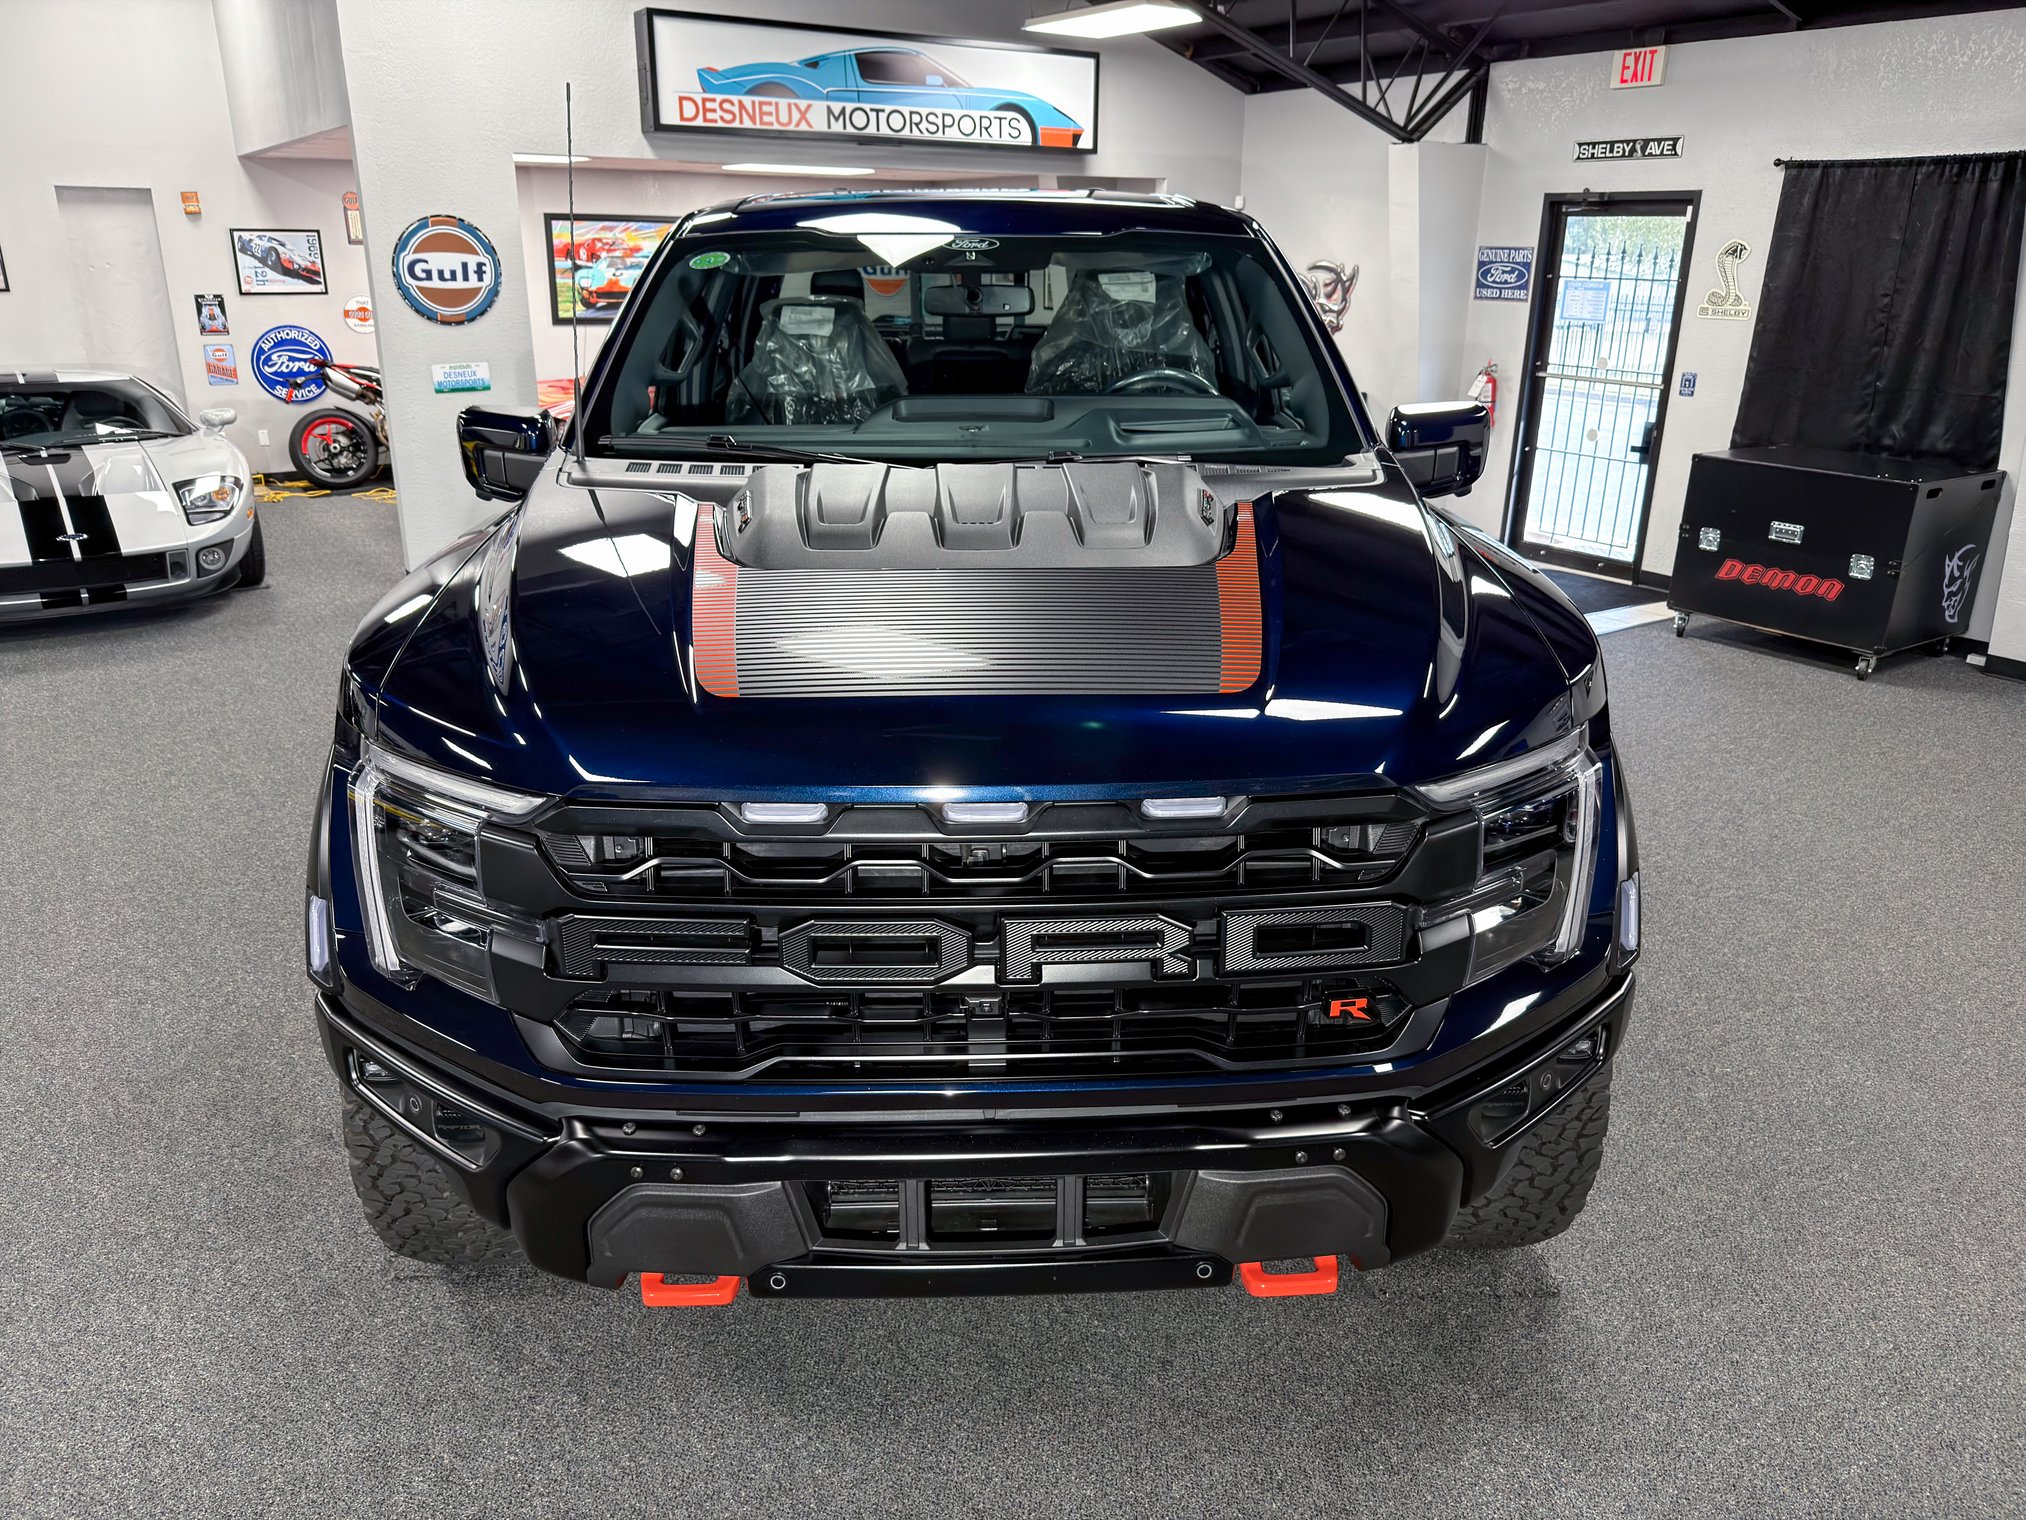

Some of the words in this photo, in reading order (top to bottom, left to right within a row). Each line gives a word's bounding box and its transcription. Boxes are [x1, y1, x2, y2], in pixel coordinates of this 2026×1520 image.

[1620, 49, 1658, 84] EXIT
[678, 95, 814, 129] DESNEUX
[826, 104, 1022, 140] MOTORSPORTS
[1579, 142, 1633, 158] SHELBY
[1645, 141, 1675, 155] AVE.
[951, 239, 990, 249] Ford
[1479, 249, 1509, 261] GENUINE
[1509, 250, 1533, 262] PARTS
[407, 258, 488, 282] Gulf
[1487, 265, 1518, 283] Ford
[1476, 288, 1500, 298] USED
[1500, 289, 1527, 299] HERE
[1710, 308, 1746, 317] SHELBY
[260, 329, 321, 352] AUTHORIZED
[437, 378, 487, 388] MOTORSPORTS
[443, 370, 477, 380] DESNEUX
[1715, 558, 1845, 601] DEMON
[558, 902, 1409, 984] FORD
[1329, 998, 1373, 1021] R
